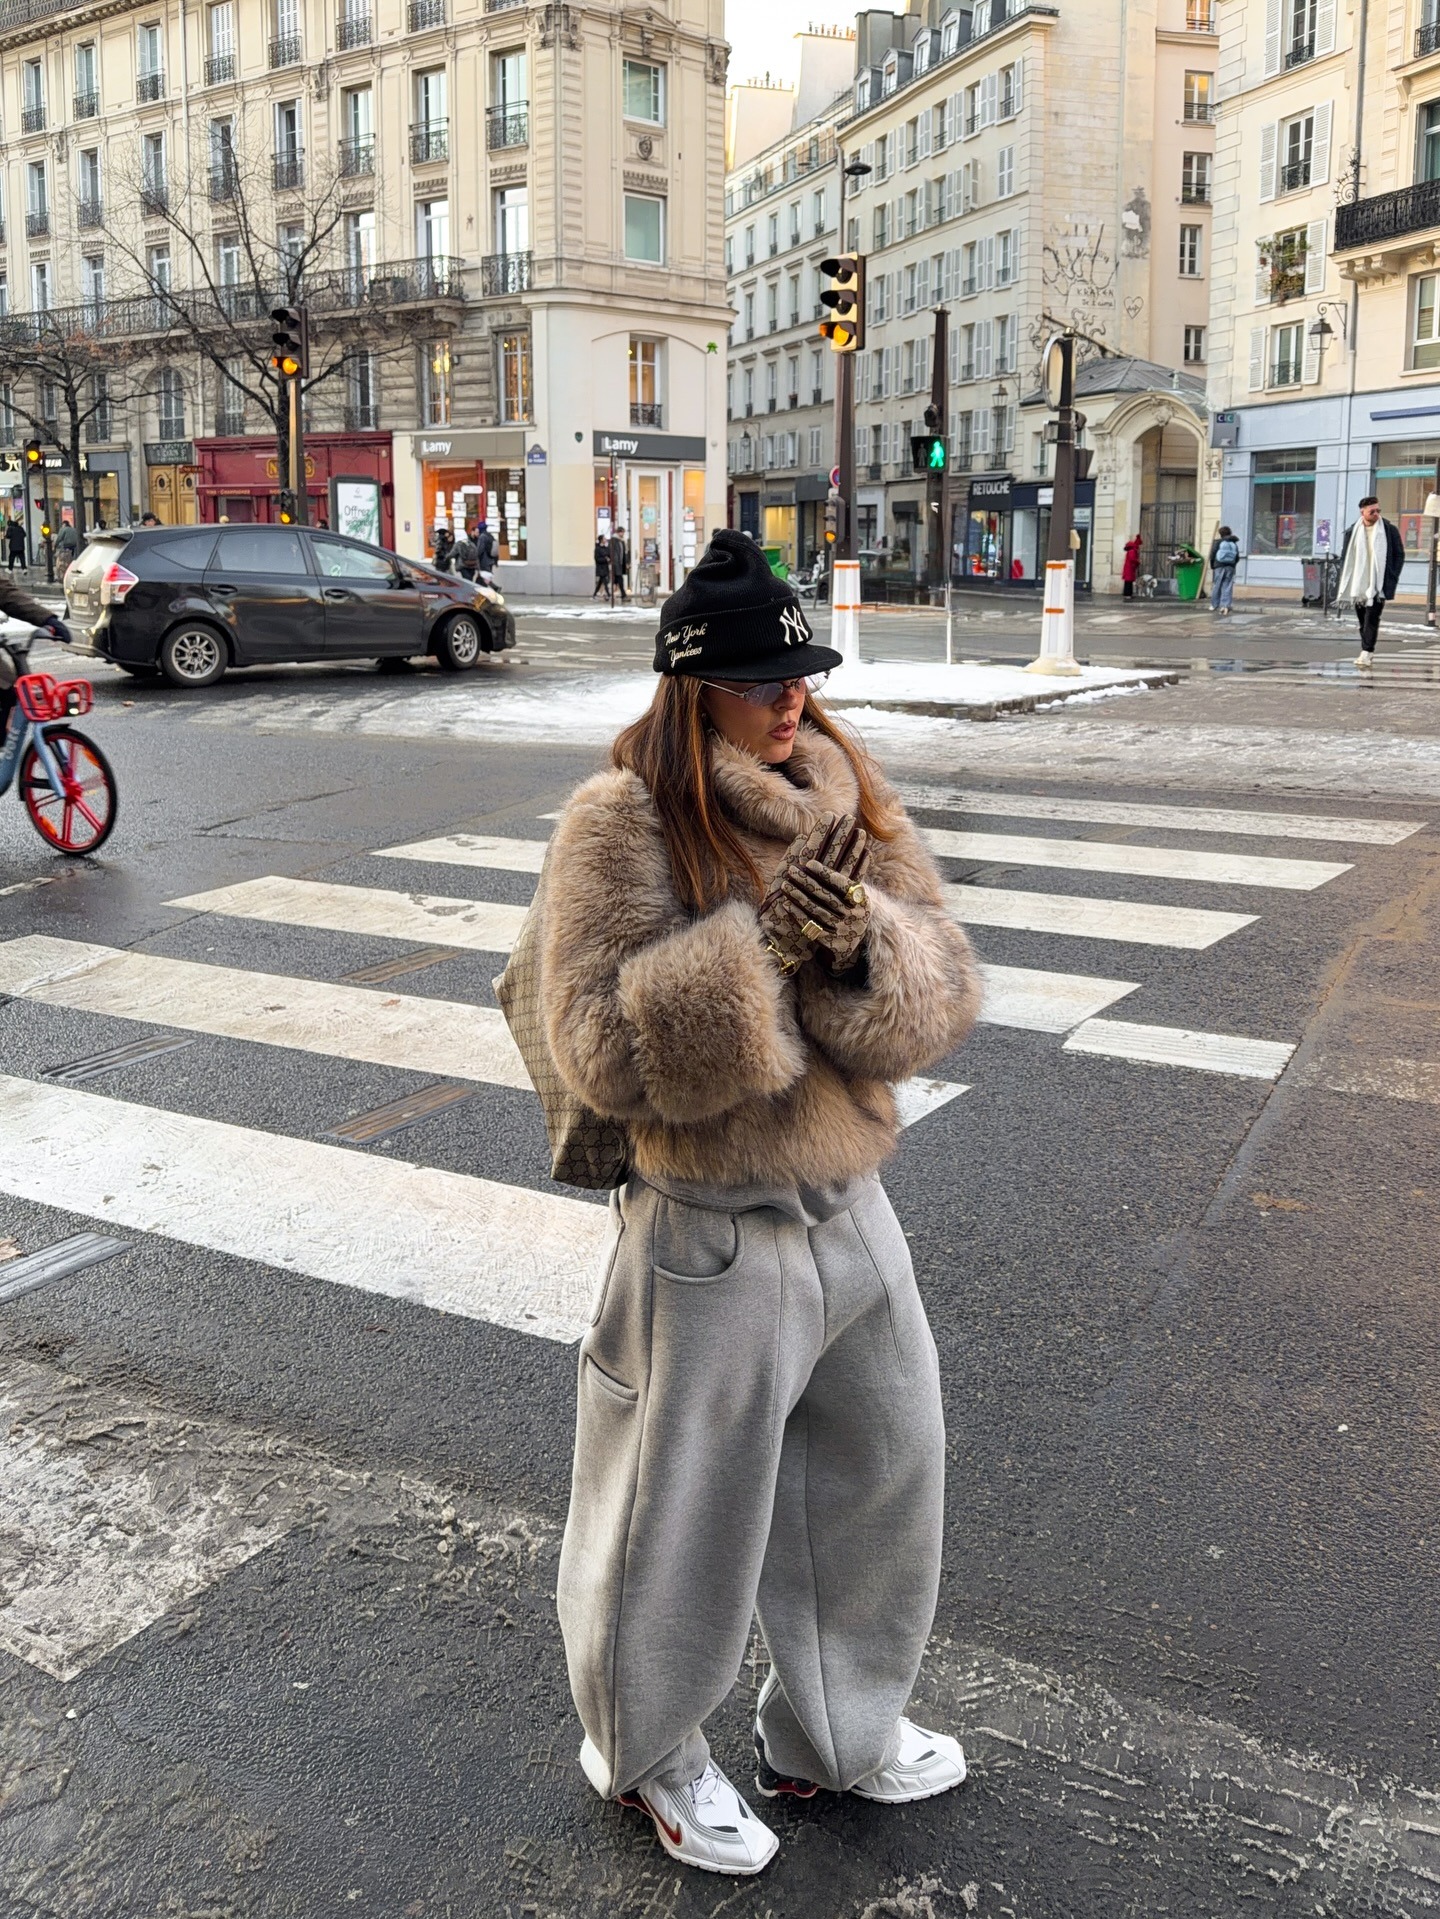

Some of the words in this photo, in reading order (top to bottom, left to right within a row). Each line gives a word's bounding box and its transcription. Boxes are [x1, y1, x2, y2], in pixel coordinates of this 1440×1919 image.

[1218, 413, 1233, 422] CIC
[422, 440, 452, 456] Lamy
[604, 436, 639, 455] Lamy
[972, 480, 1011, 496] RETOUCHE
[664, 630, 681, 646] New
[681, 622, 708, 645] York
[779, 605, 809, 646] NY
[668, 643, 703, 668] Yankees
